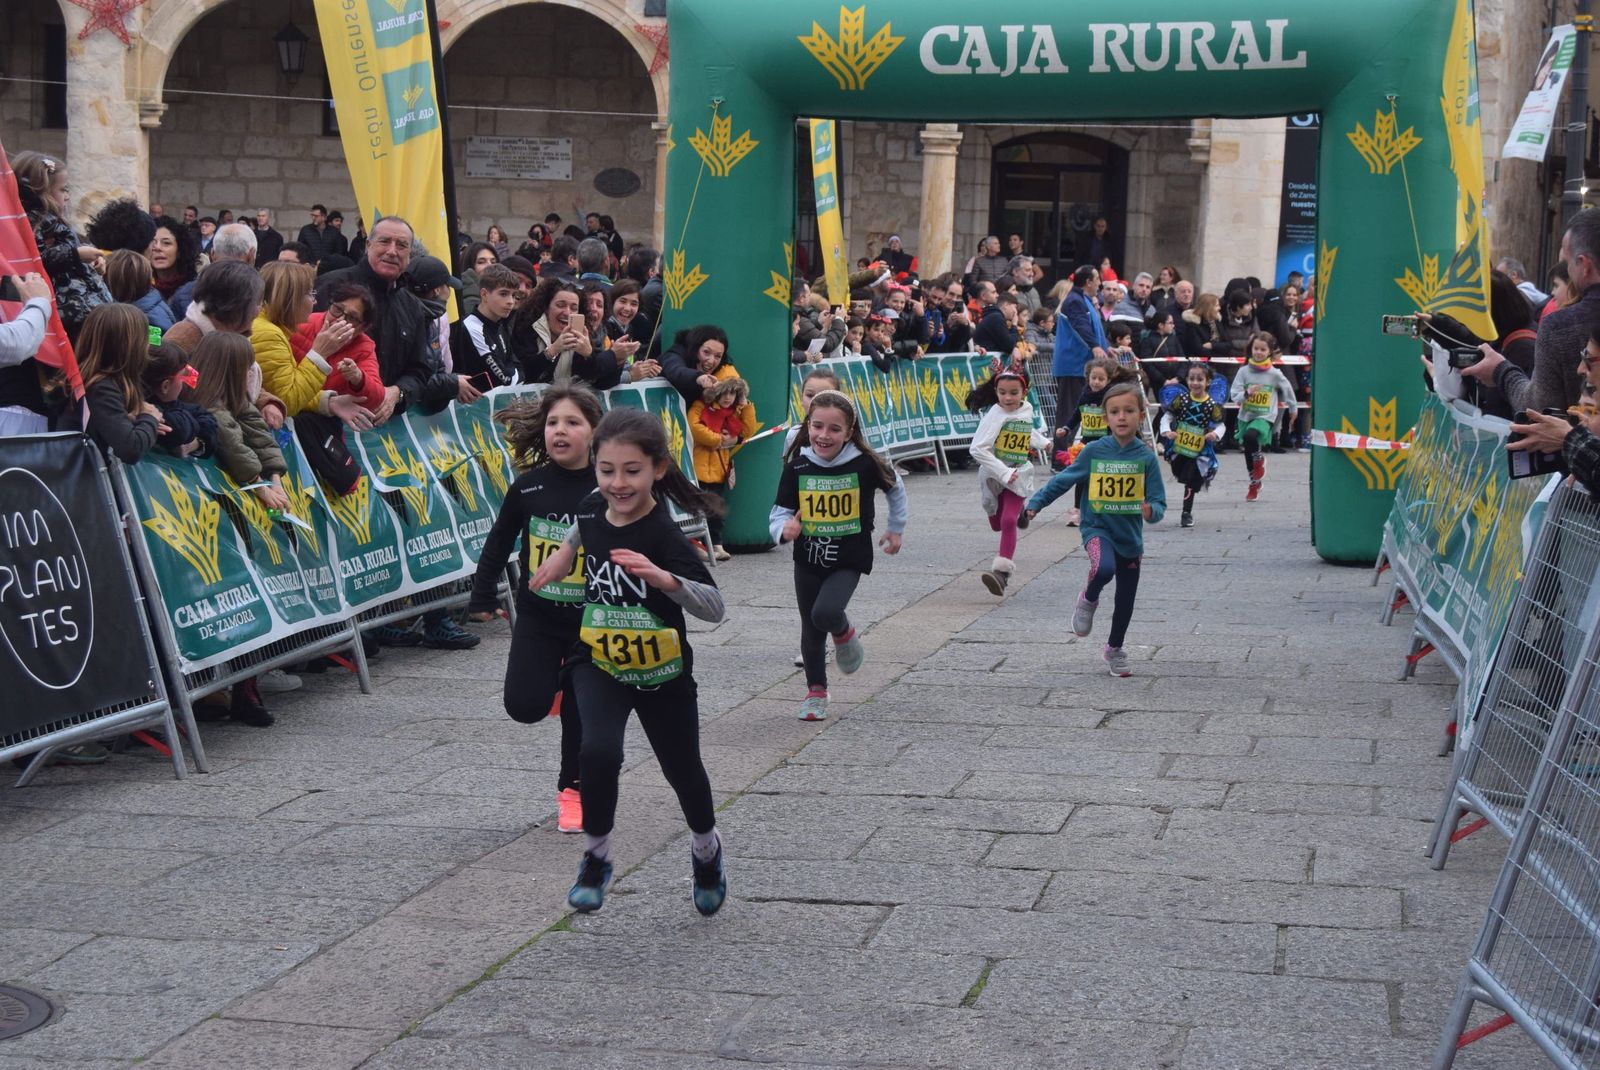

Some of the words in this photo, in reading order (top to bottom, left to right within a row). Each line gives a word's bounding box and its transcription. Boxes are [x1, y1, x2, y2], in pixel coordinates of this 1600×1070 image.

[919, 25, 1069, 77] CAJA
[1089, 19, 1307, 73] RURAL
[1179, 431, 1201, 449] 1344
[1097, 476, 1136, 497] 1312
[805, 493, 852, 518] 1400
[406, 536, 429, 556] CAJA
[426, 528, 455, 550] RURAL
[339, 556, 366, 579] CAJA
[363, 545, 398, 571] RURAL
[419, 556, 428, 567] DE
[428, 548, 453, 565] ZAMORA
[353, 578, 364, 590] DE
[364, 568, 391, 588] ZAMORA
[174, 598, 217, 628] CAJA
[214, 583, 260, 615] RURAL
[563, 588, 586, 597] RURA
[20, 605, 79, 649] TES
[198, 623, 217, 640] DE
[216, 609, 256, 634] ZAMORA
[608, 619, 630, 628] CAJA
[632, 620, 657, 629] RURA
[596, 633, 661, 666] 1311
